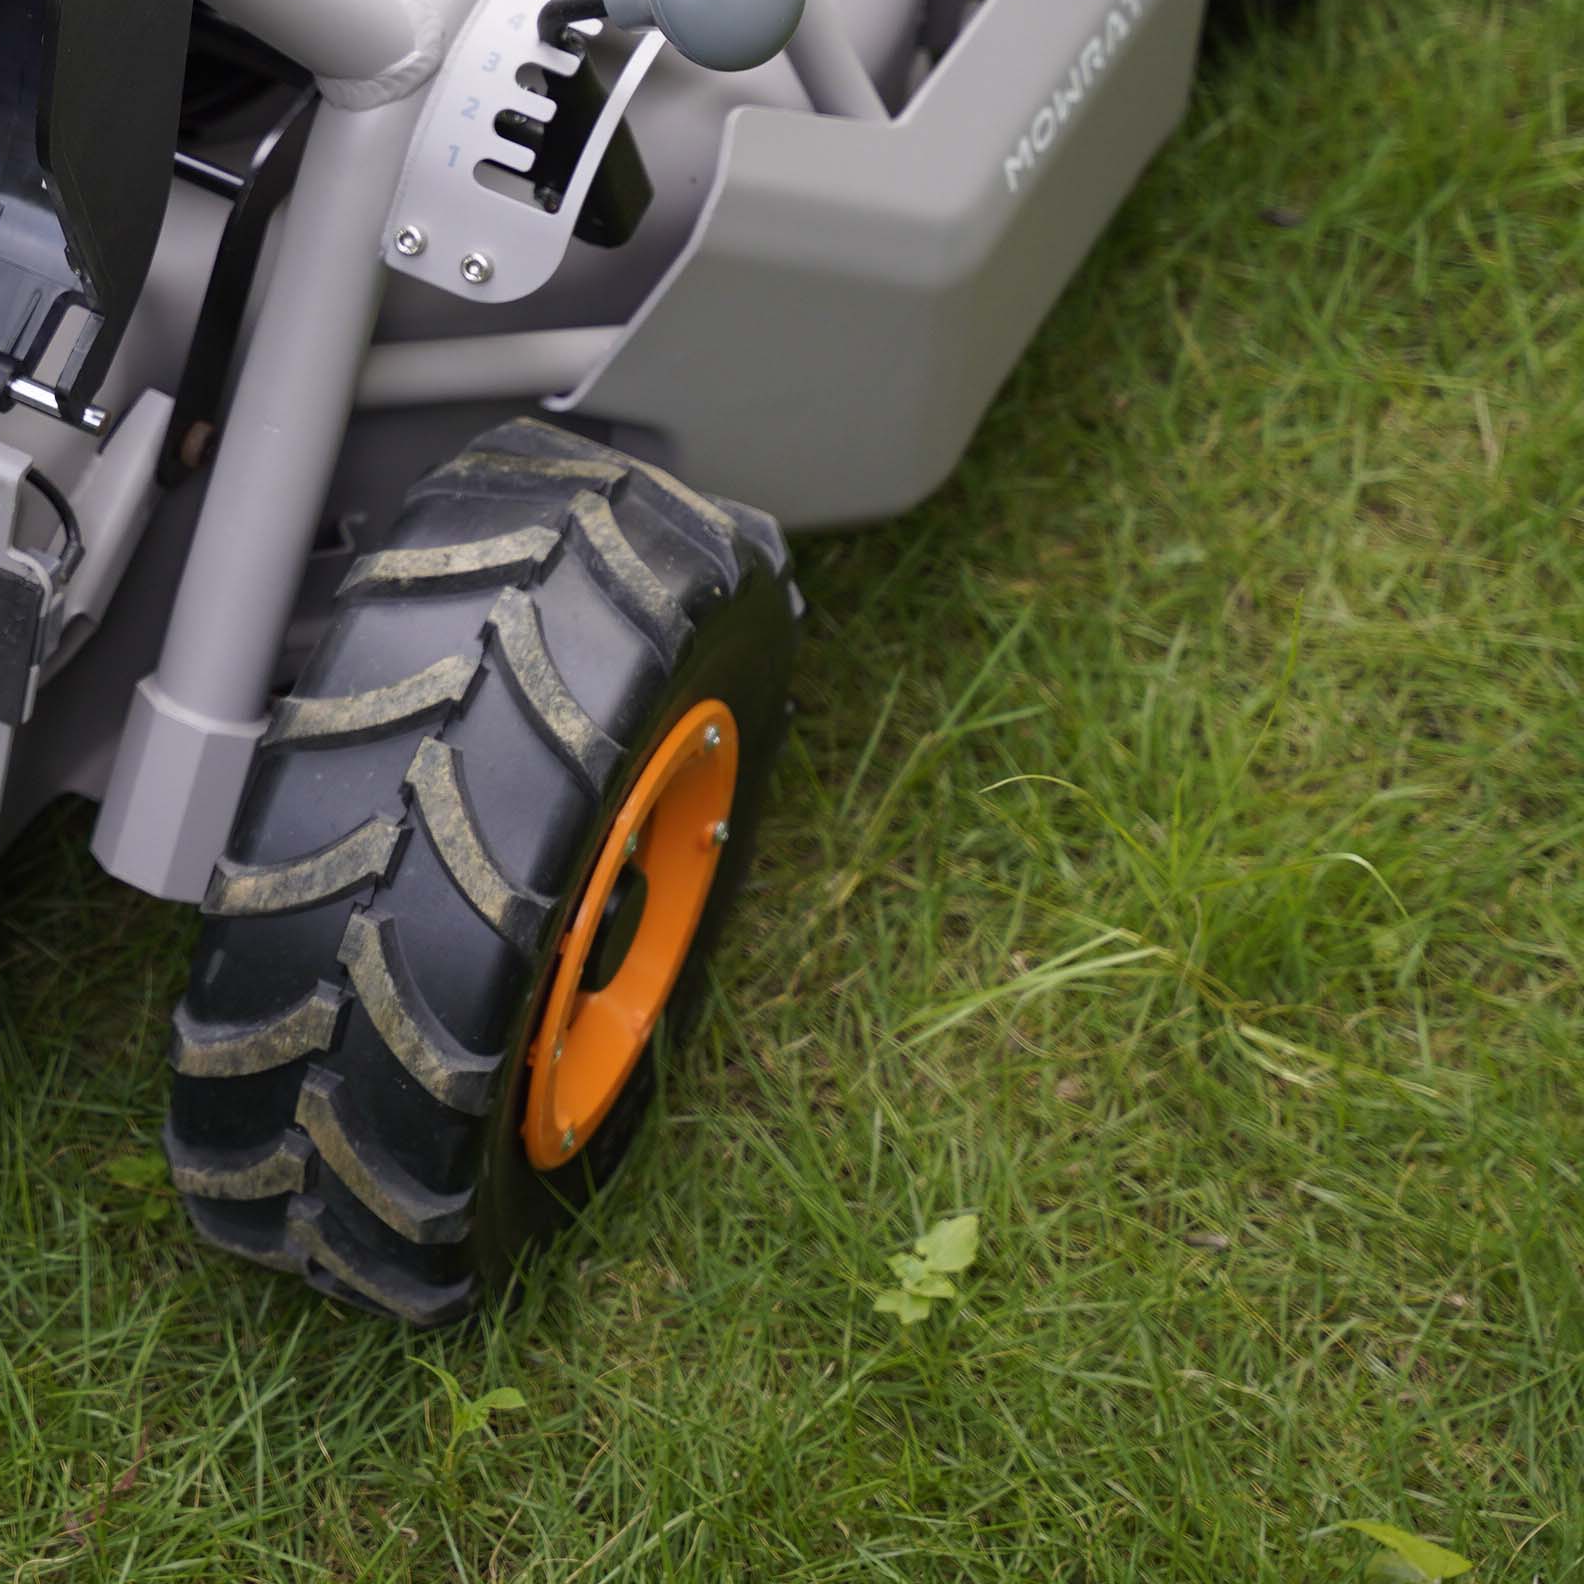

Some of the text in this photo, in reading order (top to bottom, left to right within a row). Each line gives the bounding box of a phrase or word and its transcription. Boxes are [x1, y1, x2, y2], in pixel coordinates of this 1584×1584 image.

[481, 50, 502, 73] 3
[460, 96, 481, 120] 2
[446, 143, 462, 169] 1
